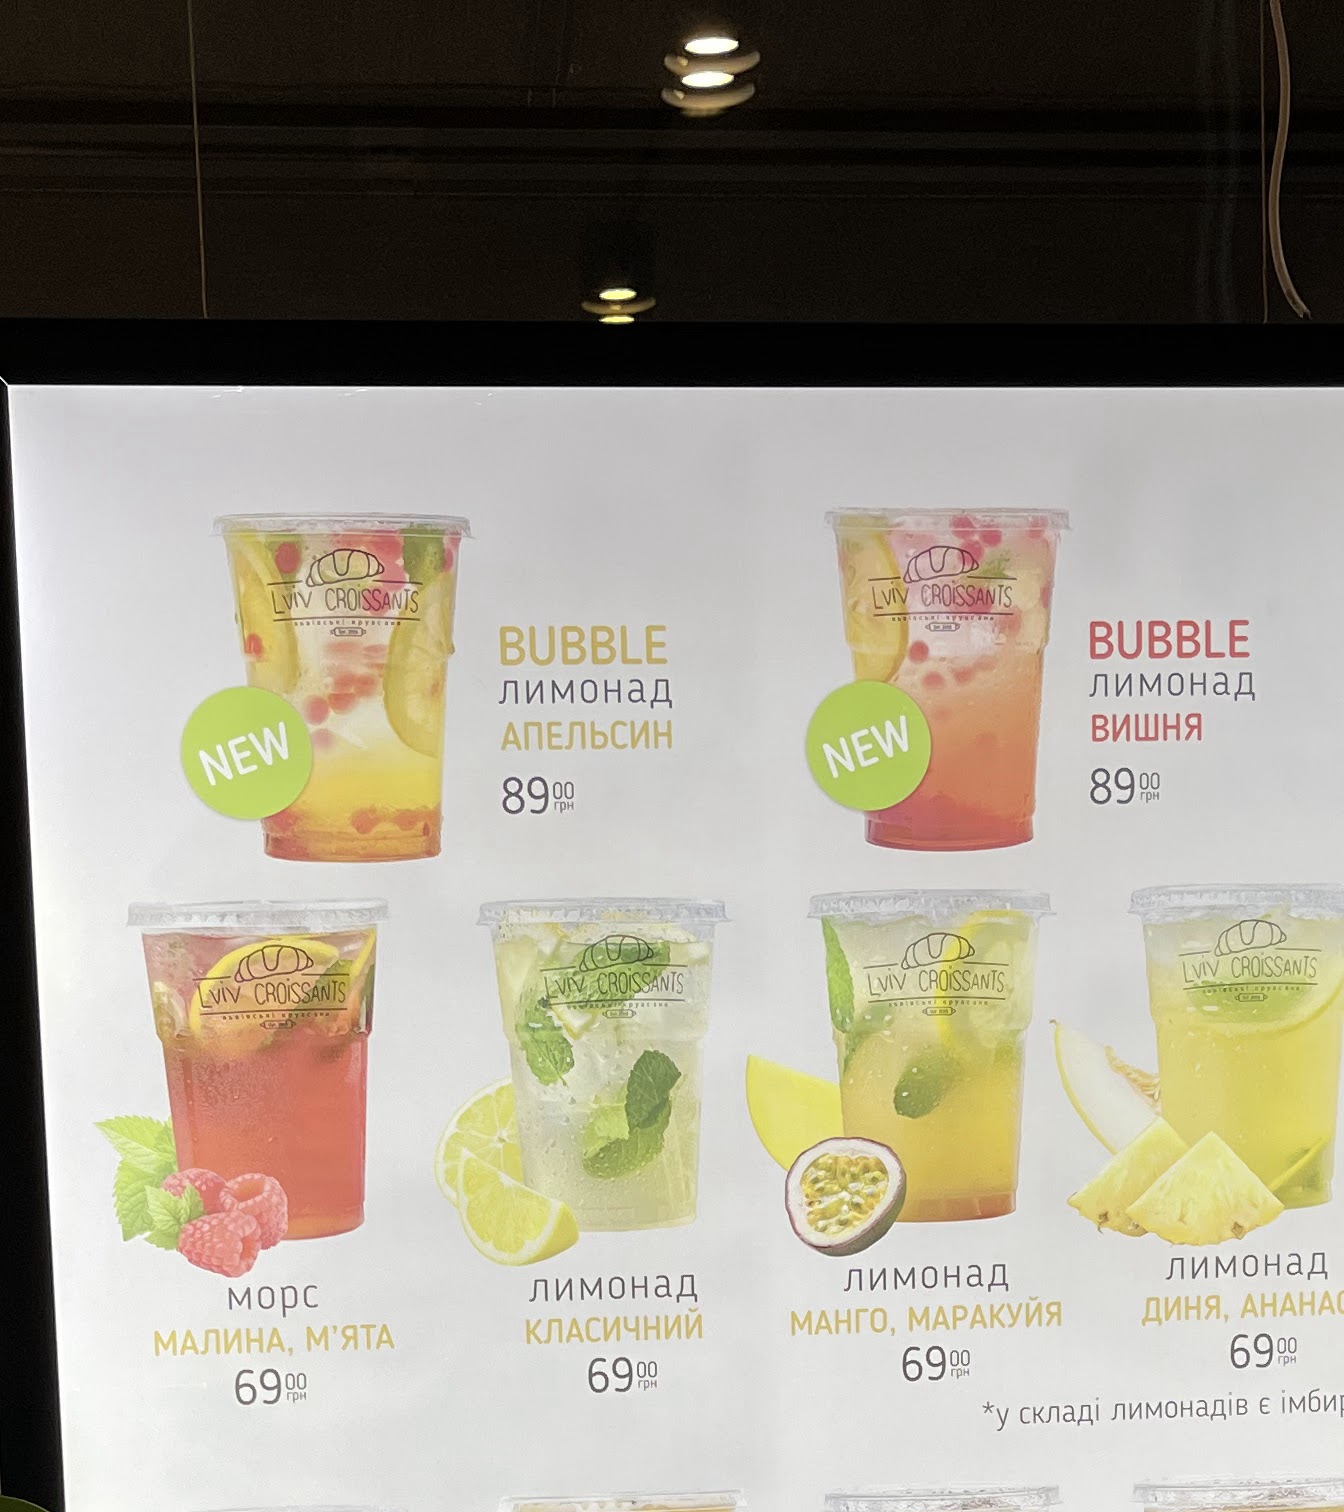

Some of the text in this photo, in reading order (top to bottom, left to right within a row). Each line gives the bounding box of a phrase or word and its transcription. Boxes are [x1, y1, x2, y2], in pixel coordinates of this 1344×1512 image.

[500, 625, 668, 666] BUBBLE
[1090, 620, 1250, 659] BUBBLE
[499, 679, 672, 709] лимонад
[1089, 672, 1255, 701] лимонад
[501, 720, 672, 751] АПЕЛЬСИН
[1092, 713, 1202, 742] ВИШНЯ
[198, 721, 289, 786] NEW
[822, 715, 909, 779] NEW
[844, 1264, 1009, 1292] лимонад
[1166, 1252, 1328, 1280] лимонад
[228, 1285, 318, 1318] морс
[529, 1275, 697, 1303] лимонад
[526, 1308, 702, 1344] КЛАСИЧНИЙ
[791, 1296, 1061, 1336] МАНГО, МАРАКУЙЯ
[1142, 1295, 1229, 1326] ДИНЯ,
[154, 1328, 293, 1356] МАЛИНА,
[1020, 1397, 1099, 1426] складі
[1111, 1392, 1248, 1421] лимонадів
[1260, 1397, 1270, 1414] є
